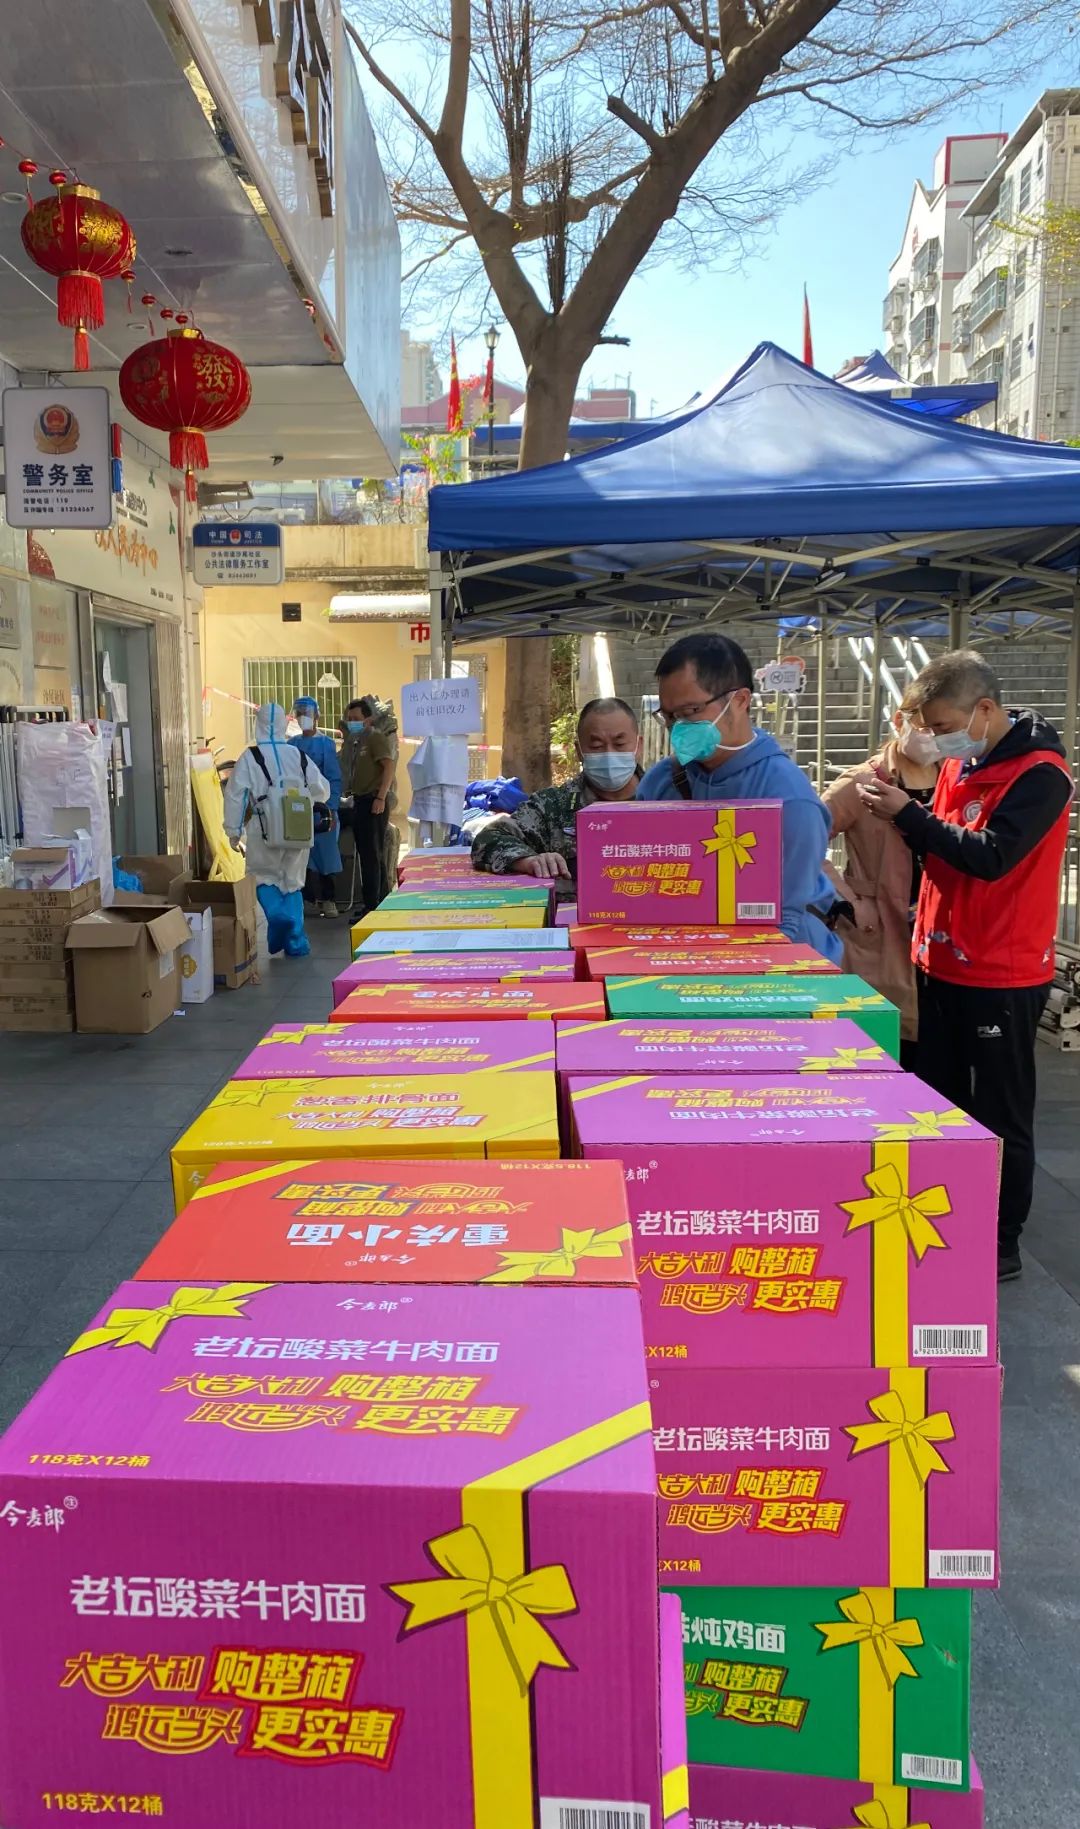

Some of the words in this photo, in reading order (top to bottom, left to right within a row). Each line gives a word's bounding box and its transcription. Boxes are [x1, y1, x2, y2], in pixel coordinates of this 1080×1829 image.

[22, 463, 94, 486] 警务室
[208, 530, 227, 540] 中国
[244, 530, 263, 540] 司法
[204, 559, 270, 569] 公共法律服务工作室
[602, 843, 692, 858] 老坛酸菜牛肉面
[647, 863, 692, 879] 购整箱
[658, 880, 704, 896] 更实惠
[321, 1036, 481, 1047] 老坛酸菜牛肉面
[669, 1108, 880, 1120] 老坛酸菜牛肉面
[275, 1183, 391, 1200] 更实惠
[298, 1200, 415, 1217] 购整箱
[285, 1223, 511, 1247] 重庆小面
[636, 1208, 820, 1237] 老坛酸菜牛肉面
[637, 1250, 727, 1280] 大吉大利
[727, 1246, 820, 1278] 购整箱
[335, 1298, 399, 1314] 今麦郎
[659, 1283, 749, 1315] 鸿运当头
[752, 1279, 844, 1312] 更实惠
[192, 1335, 501, 1363] 老坛酸菜牛肉面
[645, 1344, 689, 1359] X12桶
[161, 1372, 325, 1399] 大吉大利
[323, 1373, 484, 1402] 购整箱
[185, 1402, 353, 1433] 鸿运当头
[356, 1404, 521, 1435] 更实惠
[651, 1426, 831, 1452] 老坛酸菜牛肉面
[28, 1453, 151, 1468] 118克X12桶
[733, 1469, 823, 1499] 购整箱
[0, 1500, 65, 1533] 今麦郎
[666, 1503, 753, 1533] 鸿运当头
[756, 1502, 846, 1534] 更实惠
[659, 1559, 701, 1572] X12桶
[70, 1575, 367, 1623] 老坛酸菜牛肉面
[59, 1652, 205, 1698] 大吉大利
[209, 1650, 357, 1703] 购整箱
[701, 1659, 784, 1695] 购整箱
[723, 1692, 806, 1727] 更实惠
[102, 1704, 242, 1755] 鸿运当头
[250, 1706, 397, 1760] 更实惠
[41, 1792, 163, 1818] 118克X12桶
